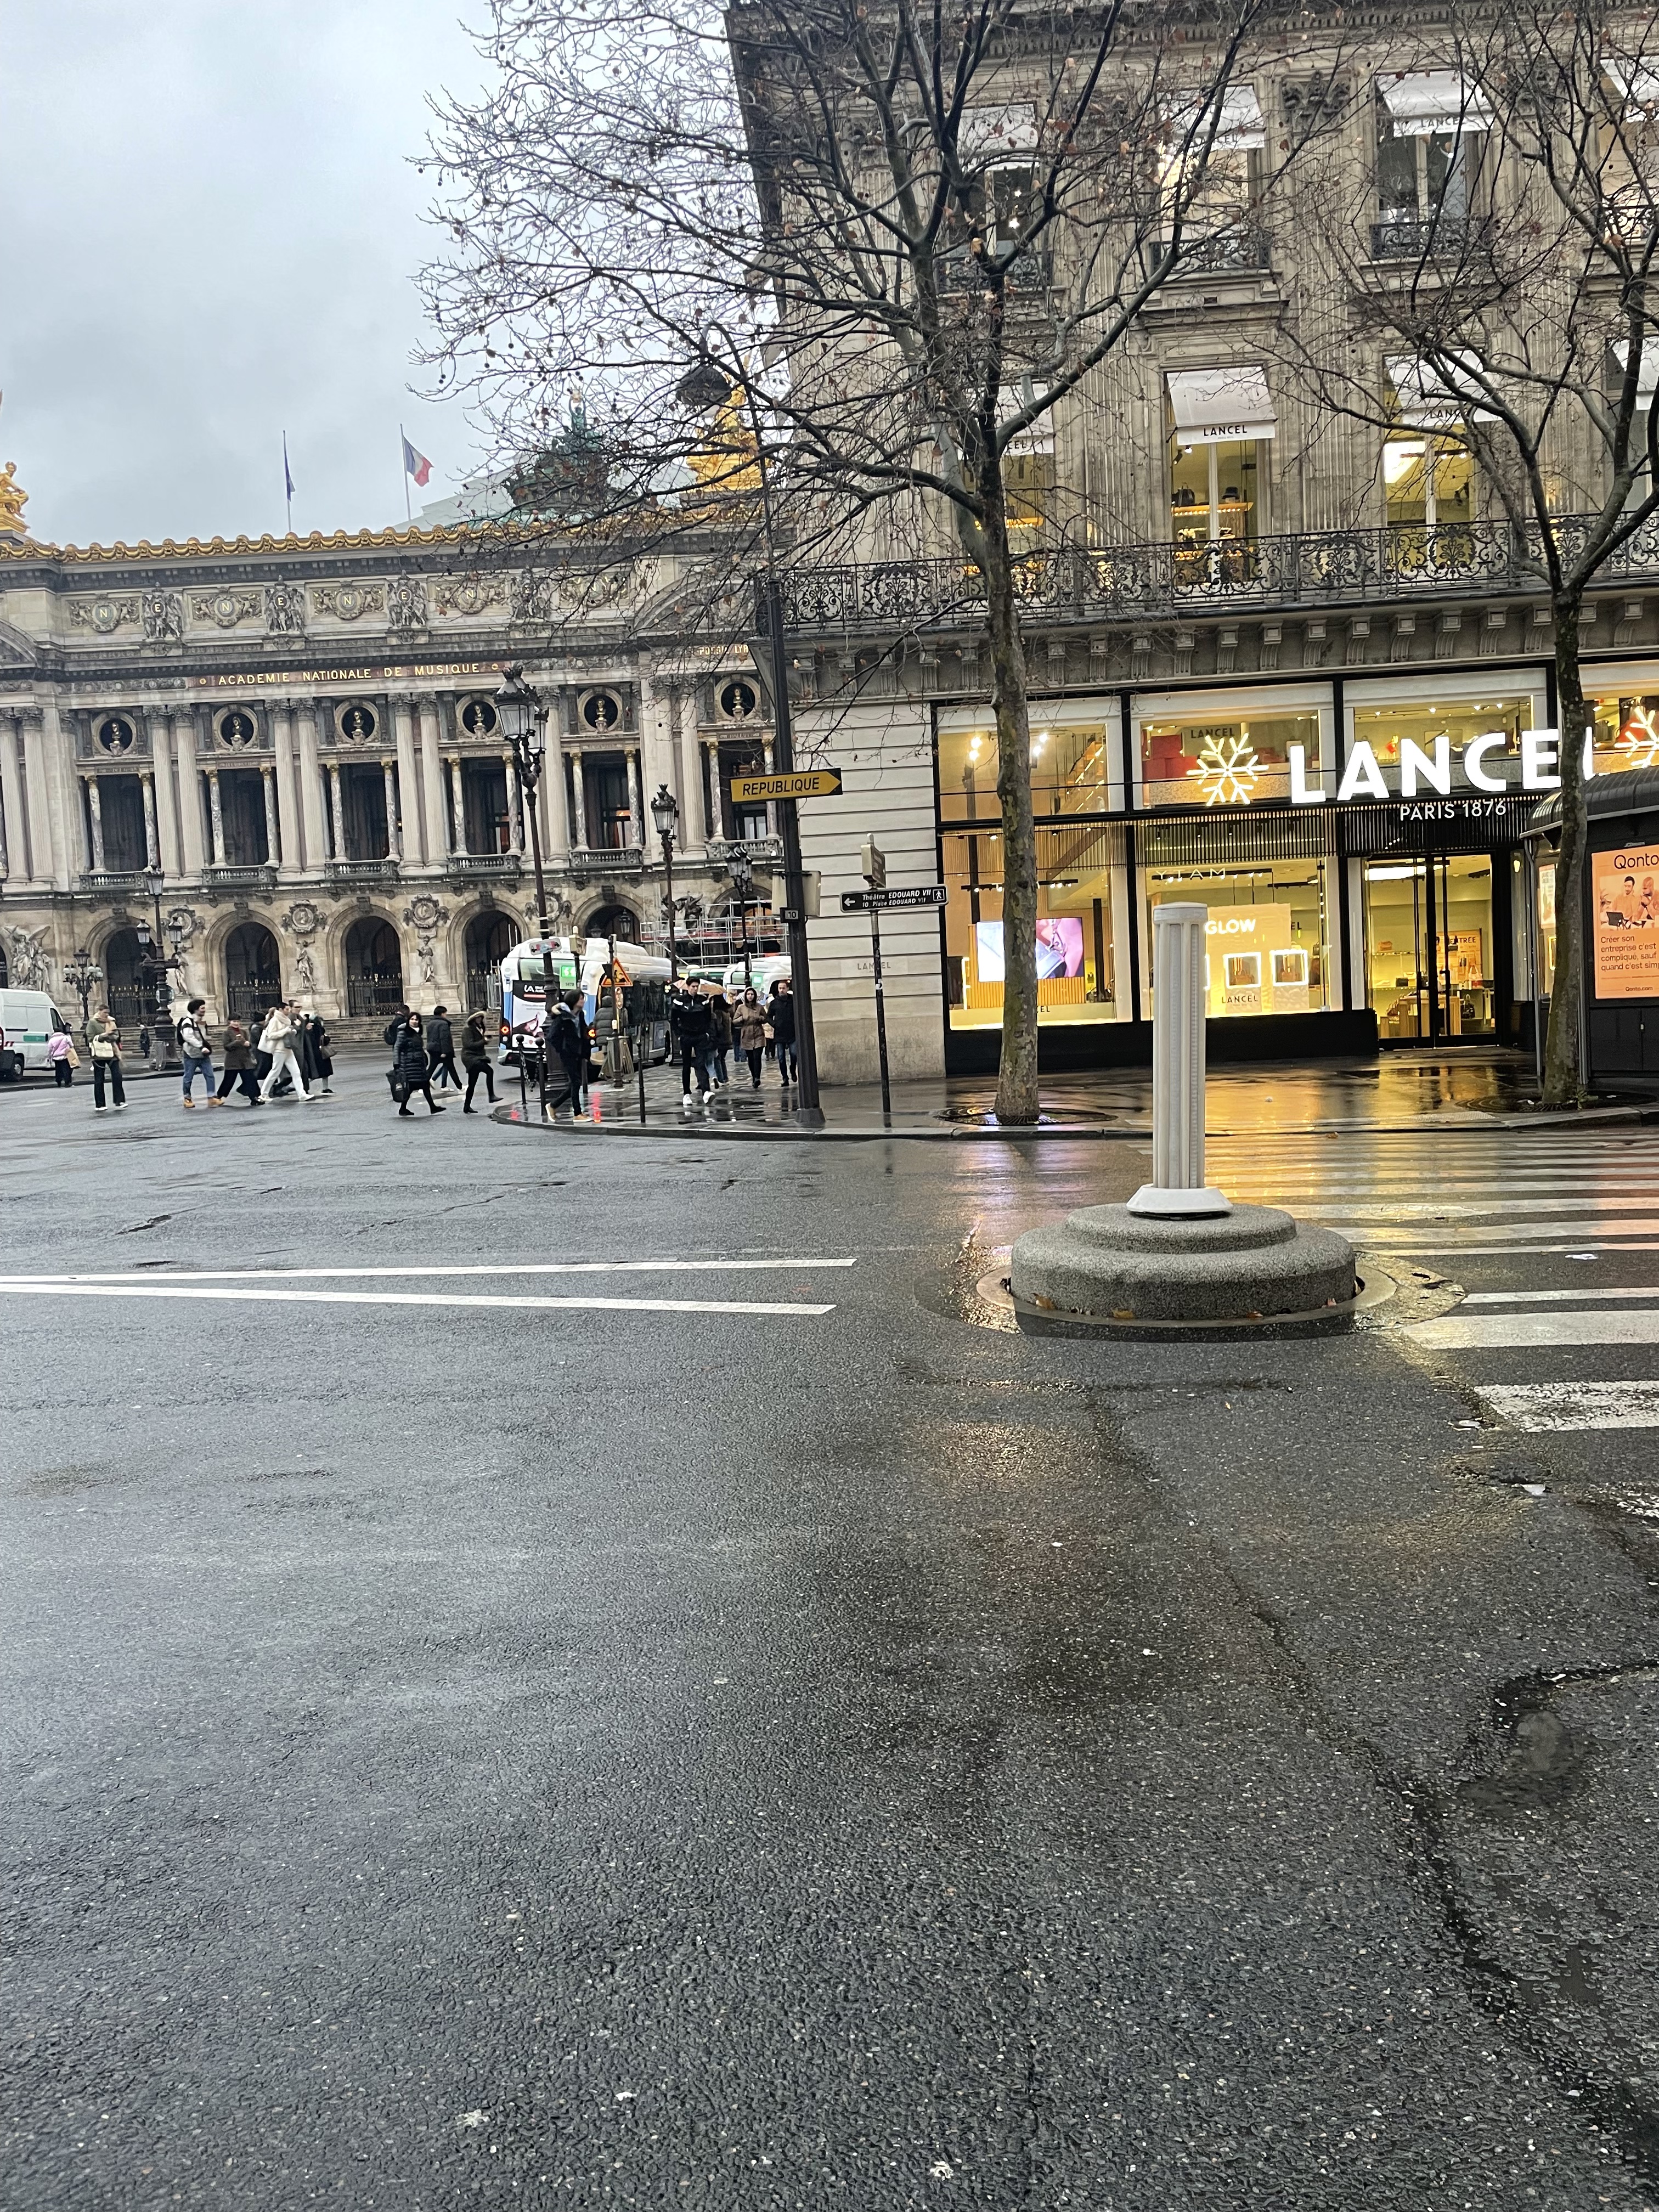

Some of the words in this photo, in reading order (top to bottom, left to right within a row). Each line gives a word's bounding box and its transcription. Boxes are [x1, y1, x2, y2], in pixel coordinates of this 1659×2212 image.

[1204, 425, 1248, 437] LANCEL
[344, 596, 352, 605] N
[401, 592, 407, 600] E
[278, 597, 284, 606] E
[155, 604, 161, 612] E
[222, 603, 229, 611] N
[99, 609, 108, 618] N
[218, 673, 290, 685] ACADEMIE
[303, 669, 371, 681] NATIONALE
[384, 667, 402, 678] DE
[414, 663, 479, 675] MUSIQUE
[1190, 727, 1235, 738] LANCEL
[742, 777, 820, 796] REPUBLIQUE
[1400, 804, 1455, 821] PARIS
[1462, 800, 1506, 817] 1876
[1614, 853, 1659, 870] Qonto
[888, 890, 920, 899] EDOUARD
[1204, 918, 1256, 935] GLOW
[1601, 943, 1637, 953] entreprise
[1601, 952, 1639, 962] compliqué,
[1640, 951, 1657, 959] sauf
[857, 962, 891, 970] LANEL
[1601, 962, 1623, 972] quand
[1221, 995, 1259, 1004] LANCEL
